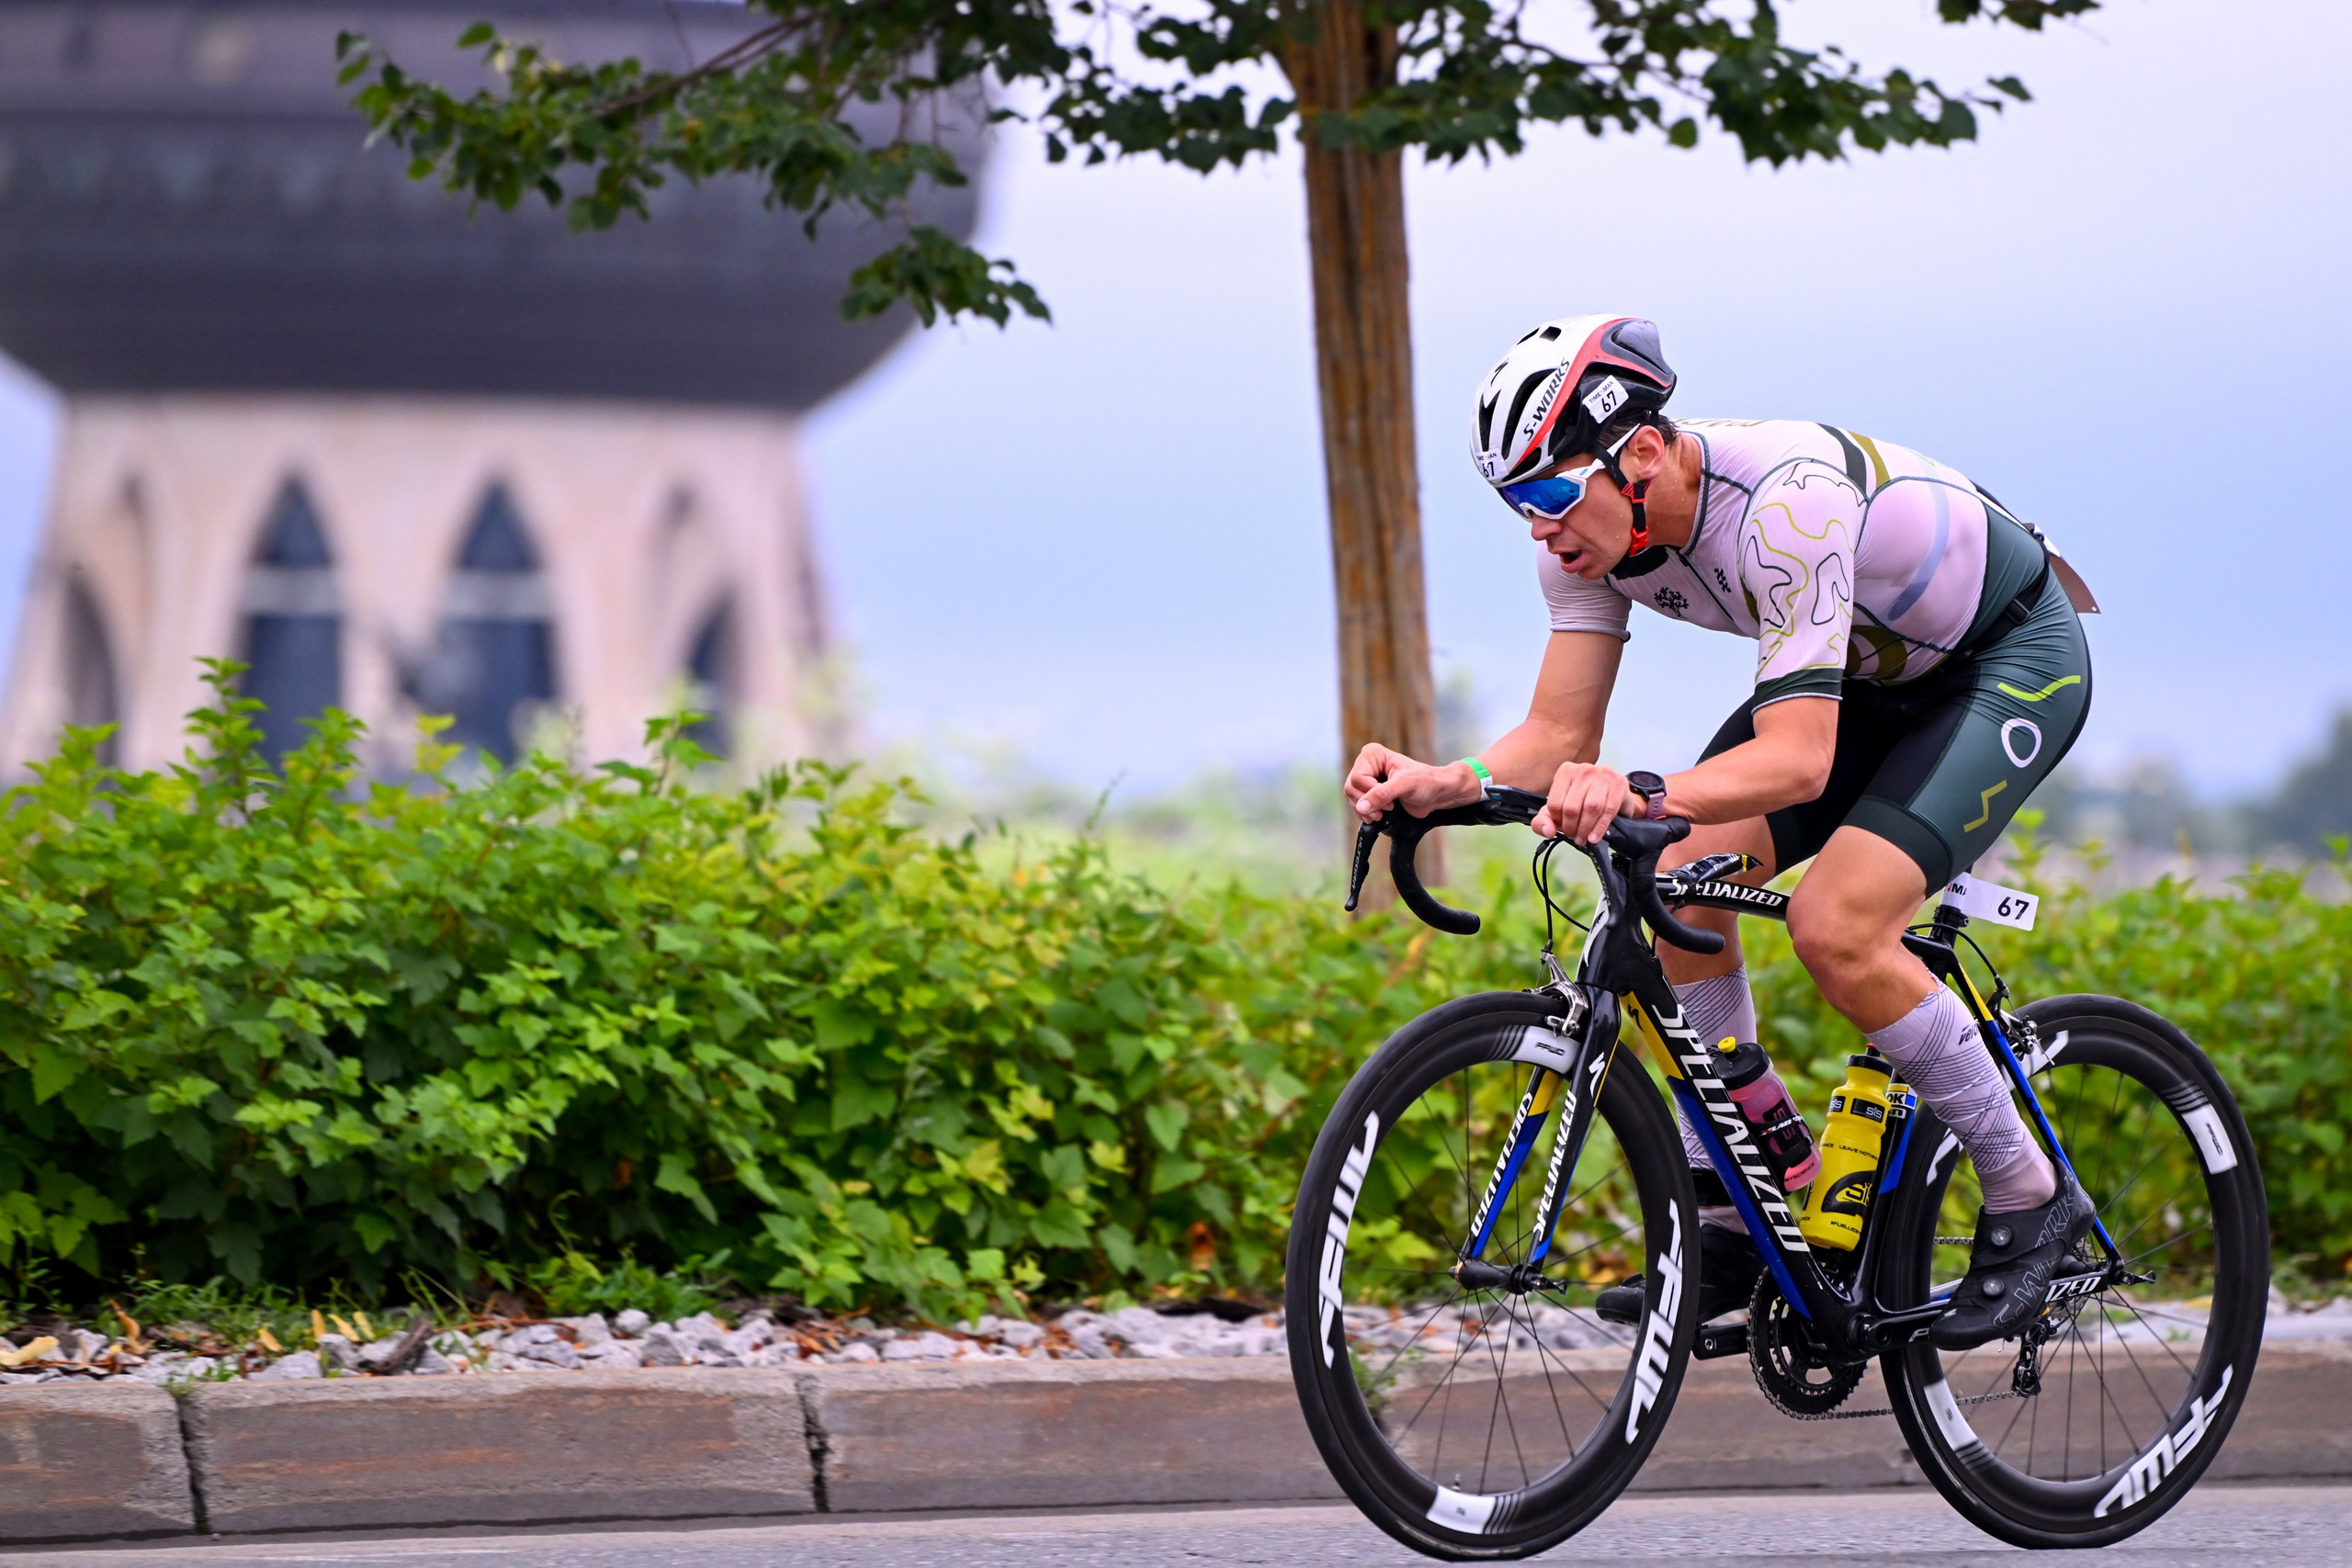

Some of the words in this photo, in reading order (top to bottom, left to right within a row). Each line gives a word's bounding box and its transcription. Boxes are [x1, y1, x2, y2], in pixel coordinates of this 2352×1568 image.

[1523, 357, 1570, 441] S-WORKS
[1601, 390, 1617, 412] 67
[1482, 461, 1495, 478] 67
[1997, 897, 2030, 920] 67
[1652, 1003, 1810, 1253] SPECIALIZED
[1784, 1162, 1815, 1182] BYSCIENCE
